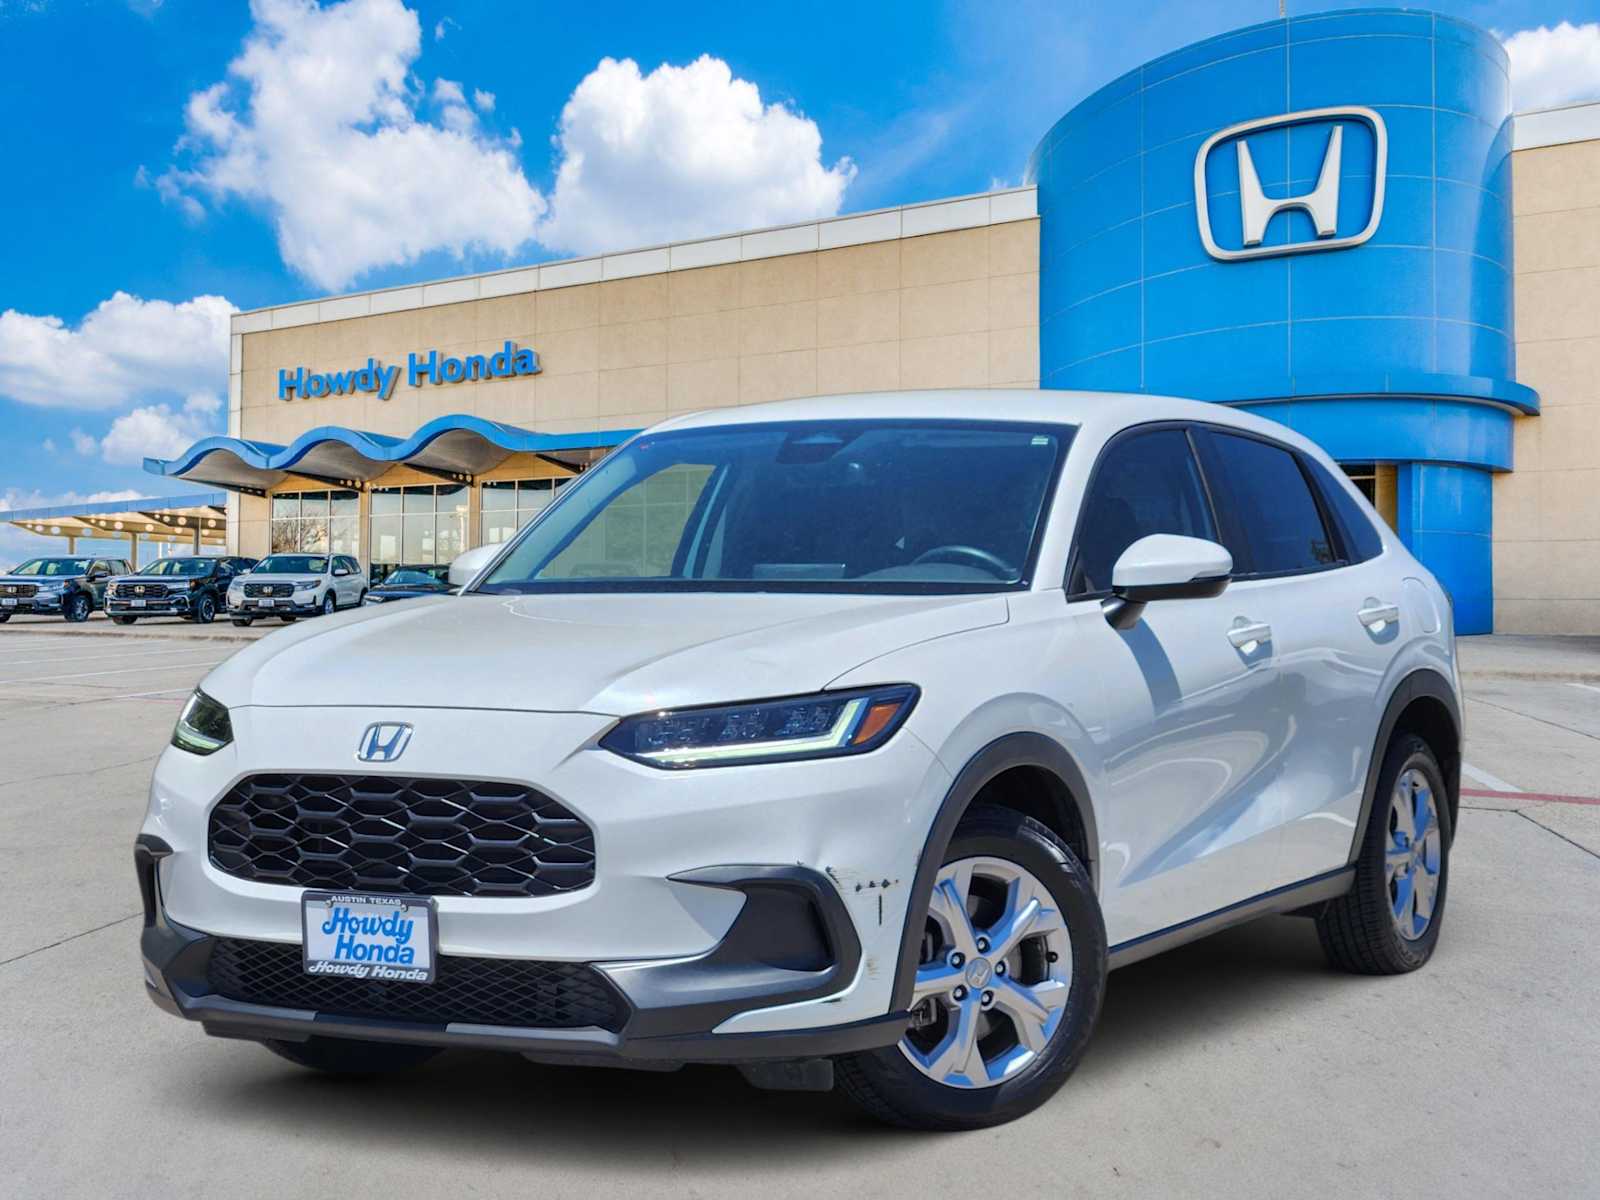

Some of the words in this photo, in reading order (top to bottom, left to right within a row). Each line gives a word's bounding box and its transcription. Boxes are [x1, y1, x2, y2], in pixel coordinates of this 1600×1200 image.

[278, 358, 401, 401] Howdy
[408, 340, 542, 389] Honda
[331, 895, 367, 904] AUSTIN
[369, 897, 402, 906] TEXAS
[322, 907, 414, 944] Howdy
[334, 934, 415, 965] Honda
[308, 961, 370, 978] Howdy
[371, 965, 428, 981] Honda
